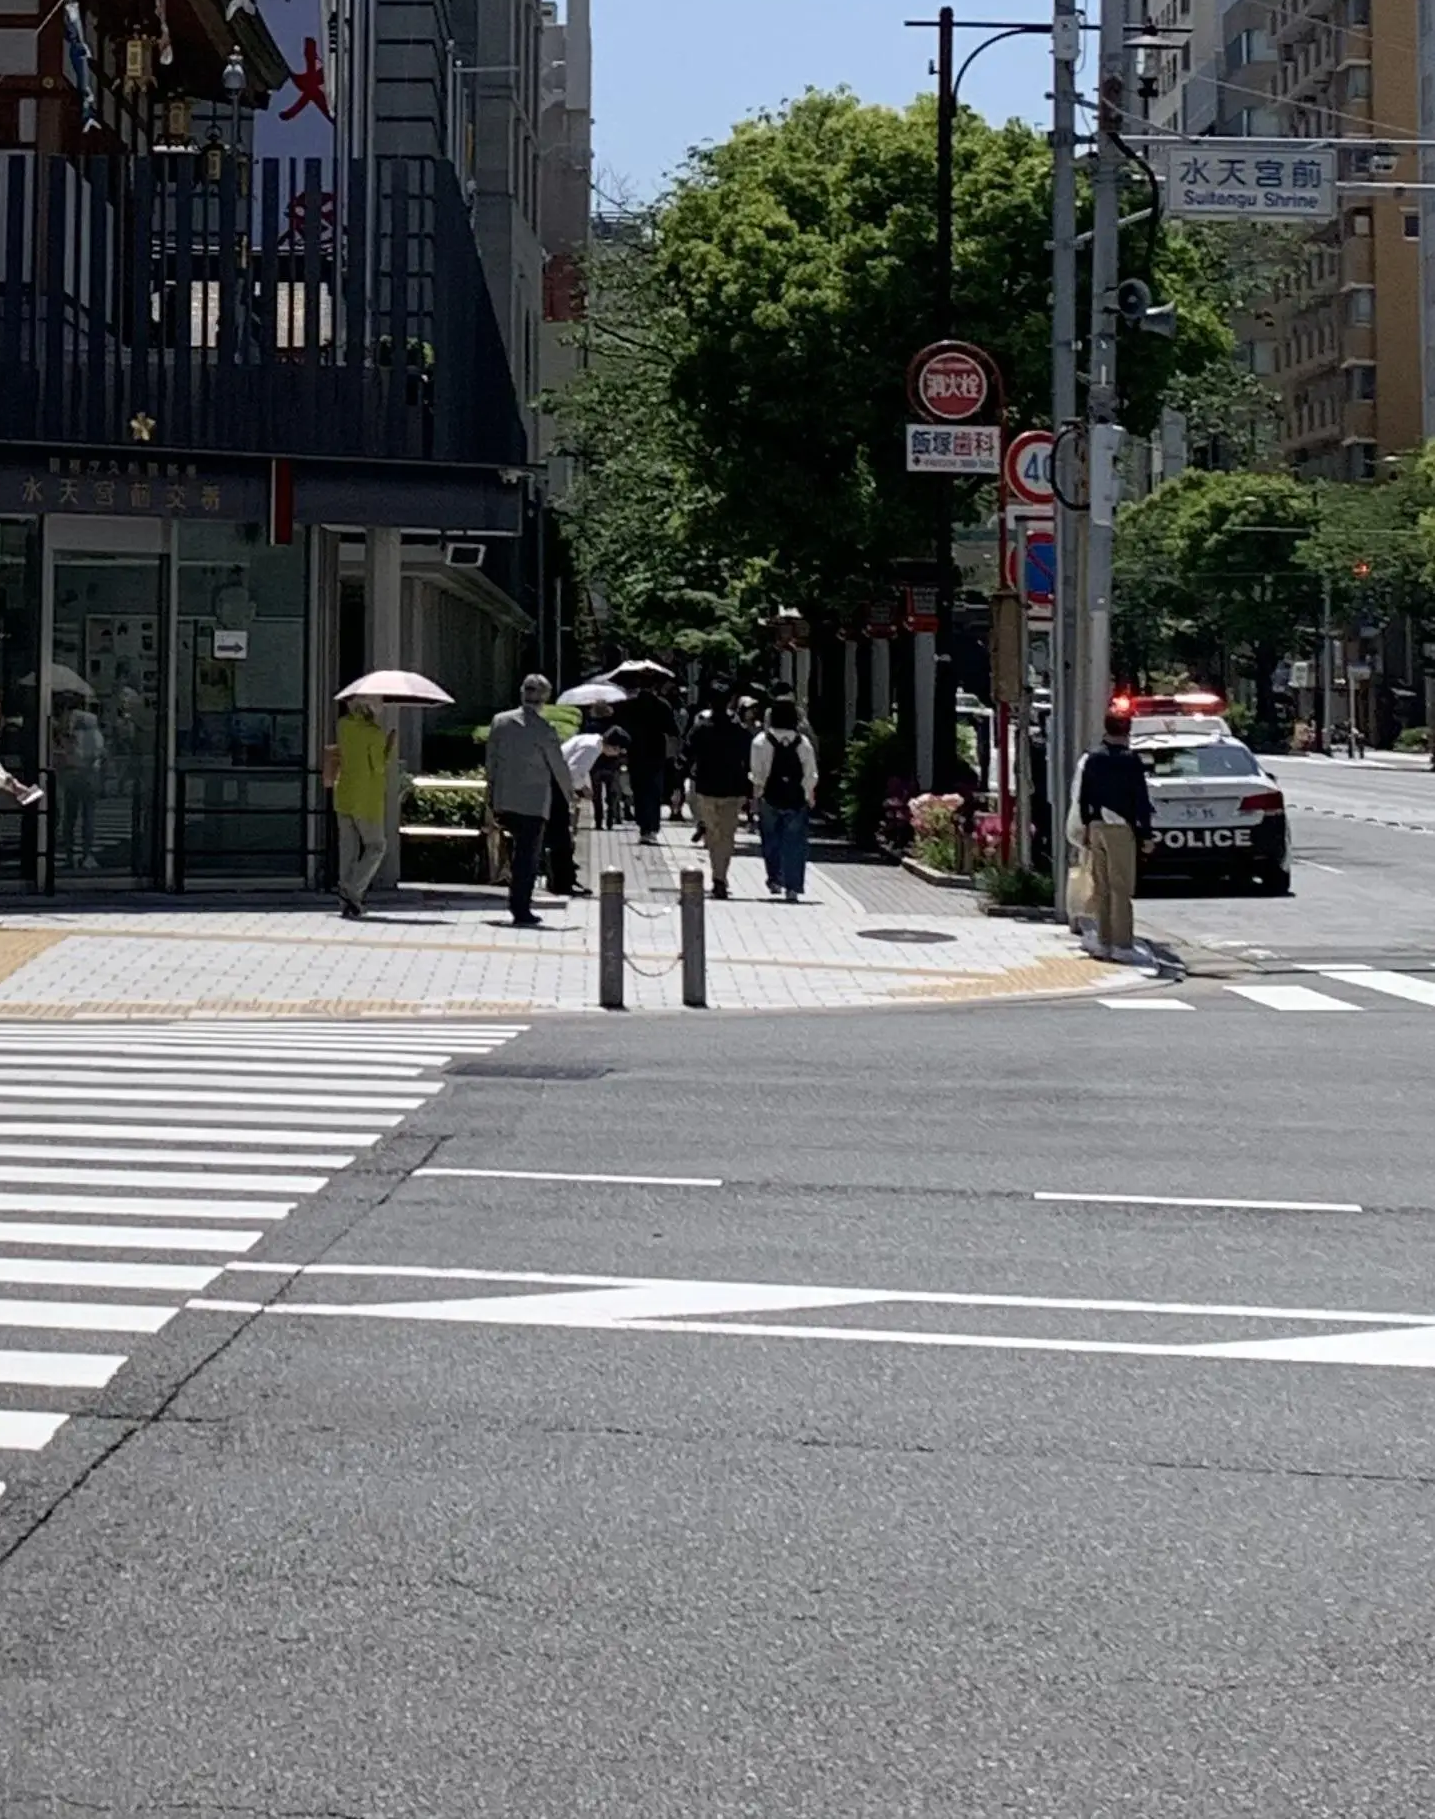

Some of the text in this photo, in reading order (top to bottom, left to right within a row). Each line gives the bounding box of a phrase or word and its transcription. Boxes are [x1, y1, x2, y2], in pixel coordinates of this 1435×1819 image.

[1179, 156, 1322, 189] 水天宮前
[1264, 191, 1319, 209] Shrine
[926, 372, 981, 398] 消火栓
[911, 431, 994, 457] 飯塚歯科
